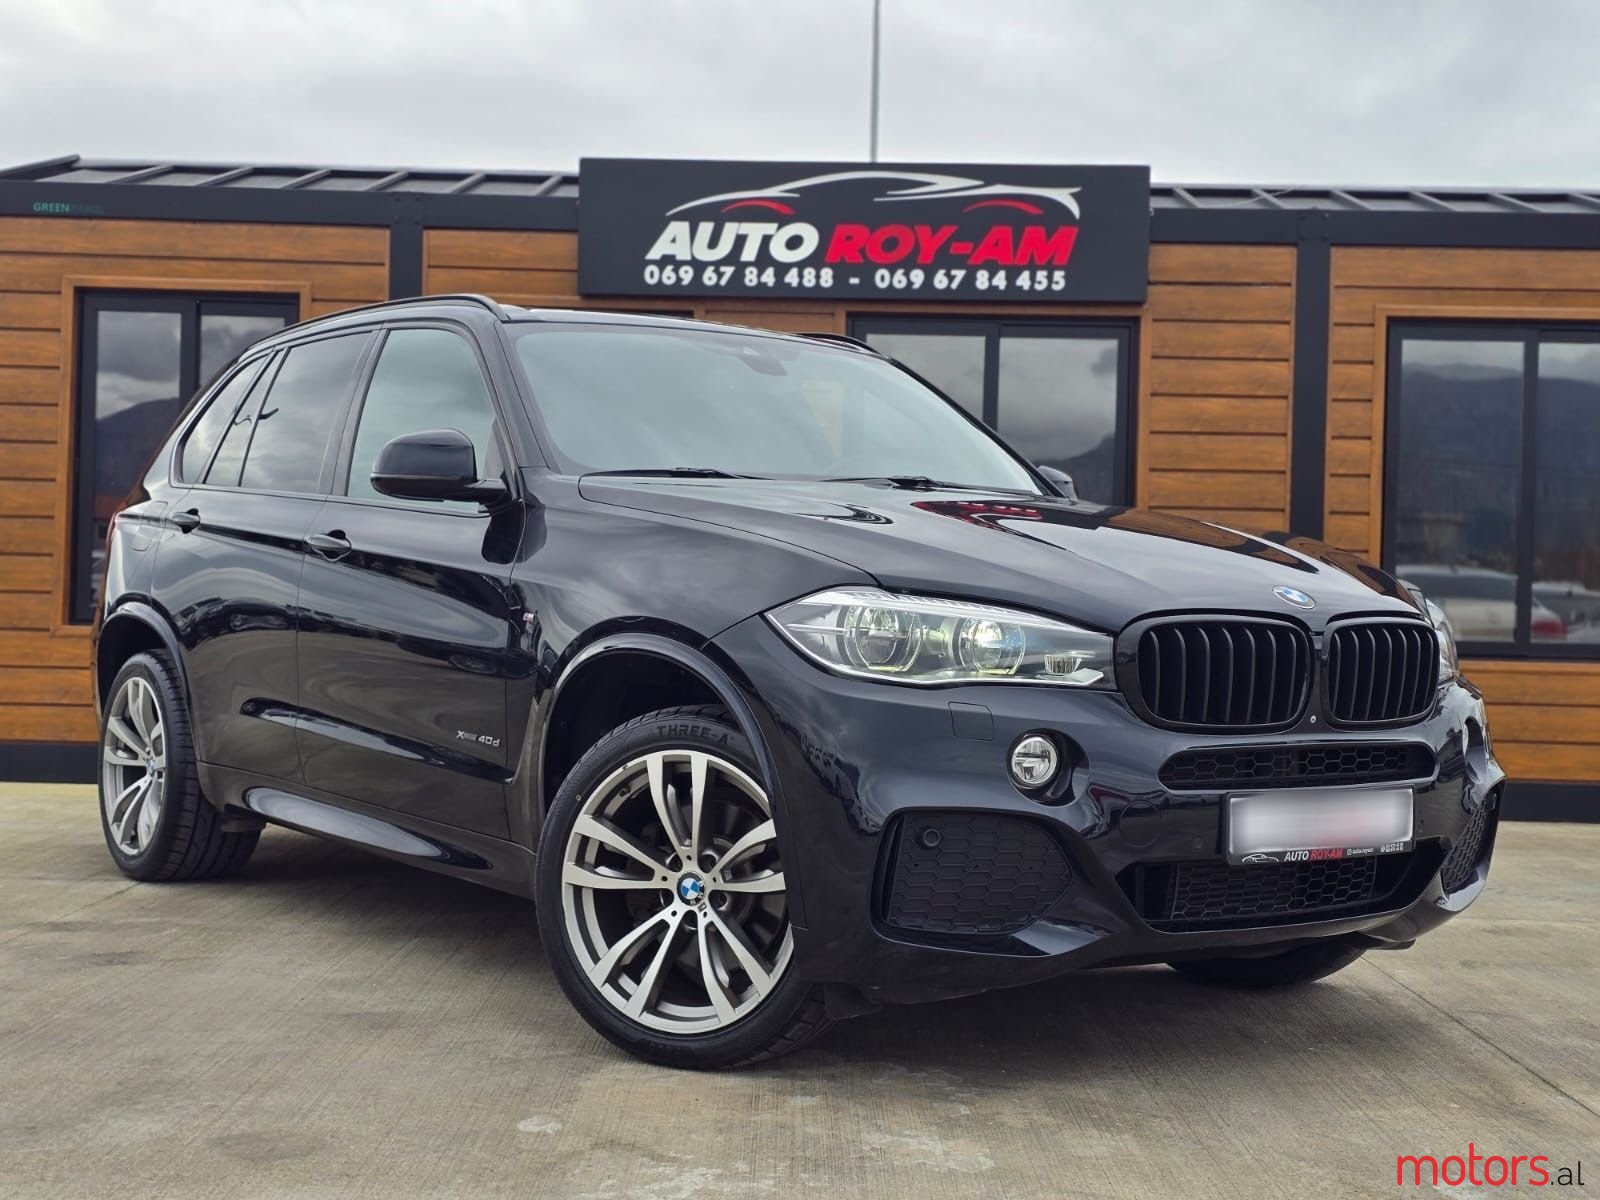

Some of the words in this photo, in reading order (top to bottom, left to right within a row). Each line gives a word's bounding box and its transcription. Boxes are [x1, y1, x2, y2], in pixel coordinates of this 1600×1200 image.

[645, 220, 819, 264] AUTO
[825, 223, 1079, 267] ROY-AM
[643, 265, 693, 286] 069
[703, 266, 735, 287] 67
[744, 267, 776, 287] 84
[784, 267, 833, 288] 488
[875, 269, 924, 290] 069
[934, 270, 966, 290] 67
[976, 270, 1008, 291] 84
[1016, 271, 1066, 291] 455
[1284, 851, 1309, 862] AUTO
